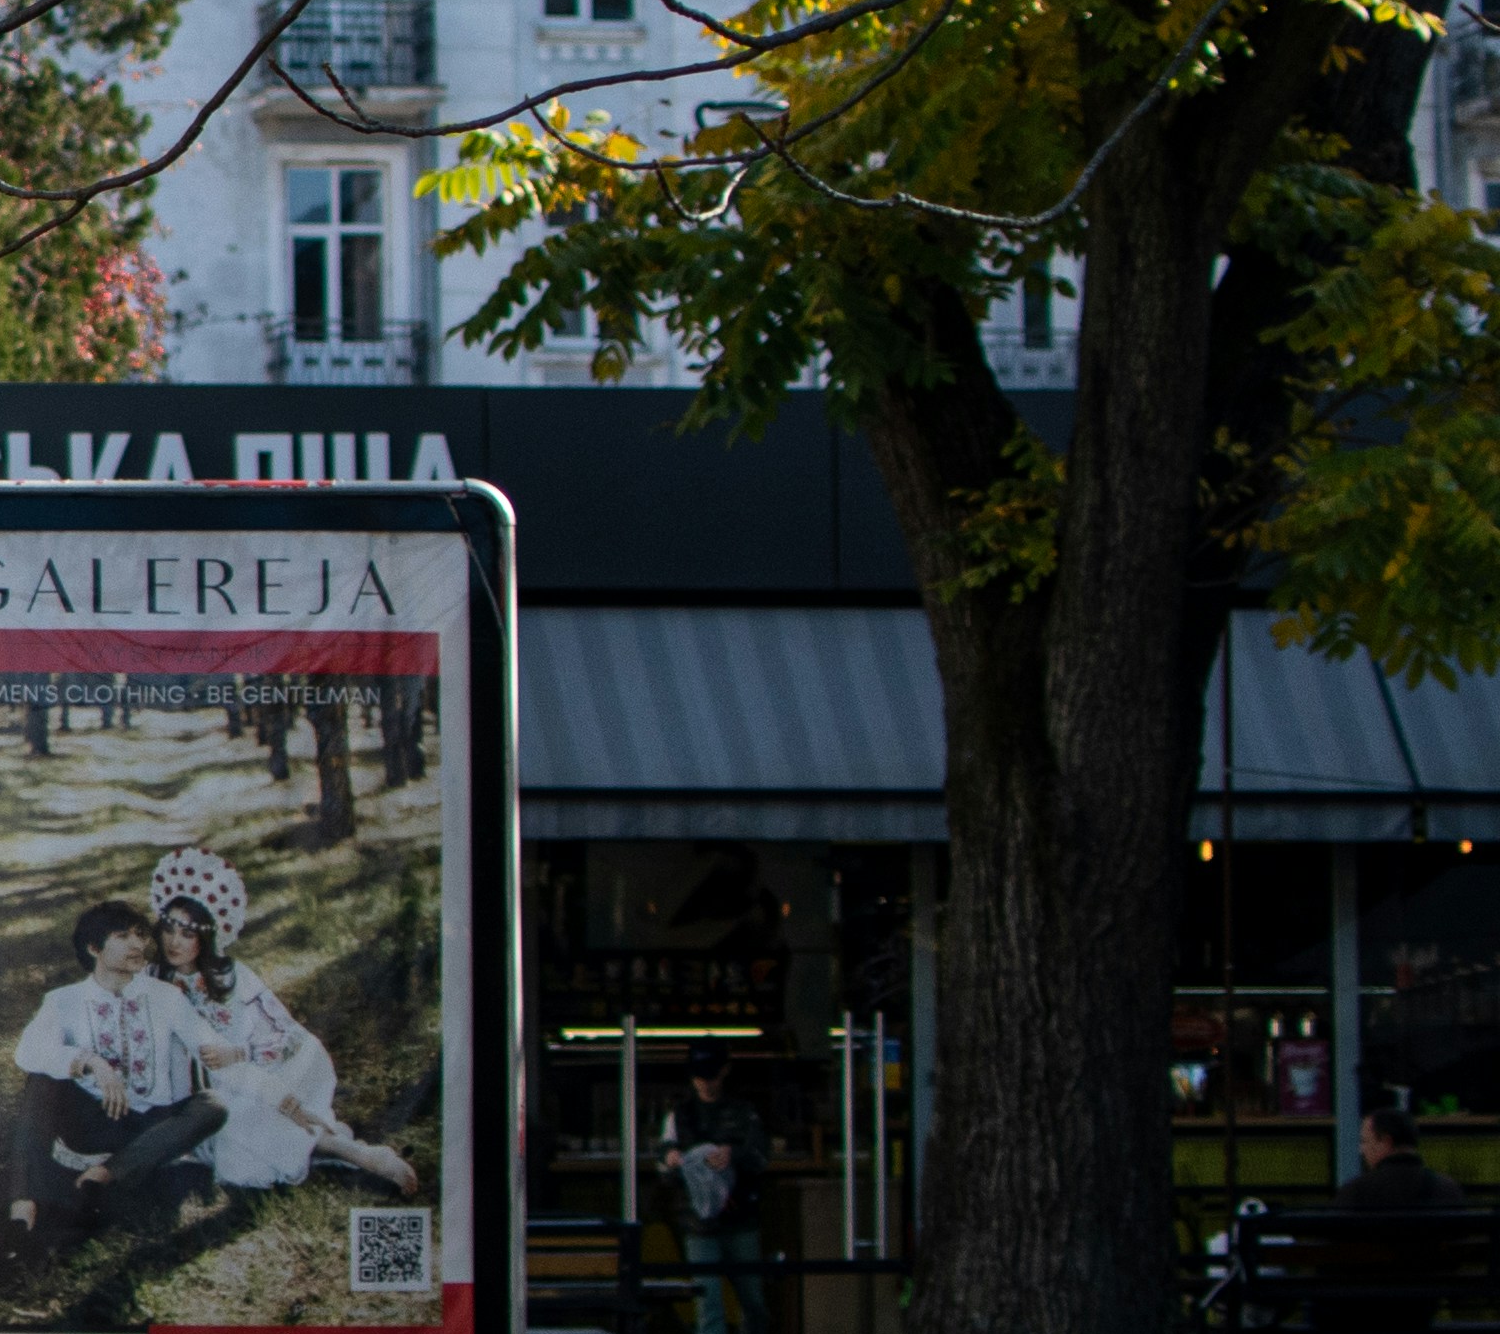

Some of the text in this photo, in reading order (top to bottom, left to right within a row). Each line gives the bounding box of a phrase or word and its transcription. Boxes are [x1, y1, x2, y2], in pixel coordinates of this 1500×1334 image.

[65, 684, 186, 705] CLOTHING
[207, 685, 234, 704] BE
[242, 684, 382, 706] GENTELMAN
